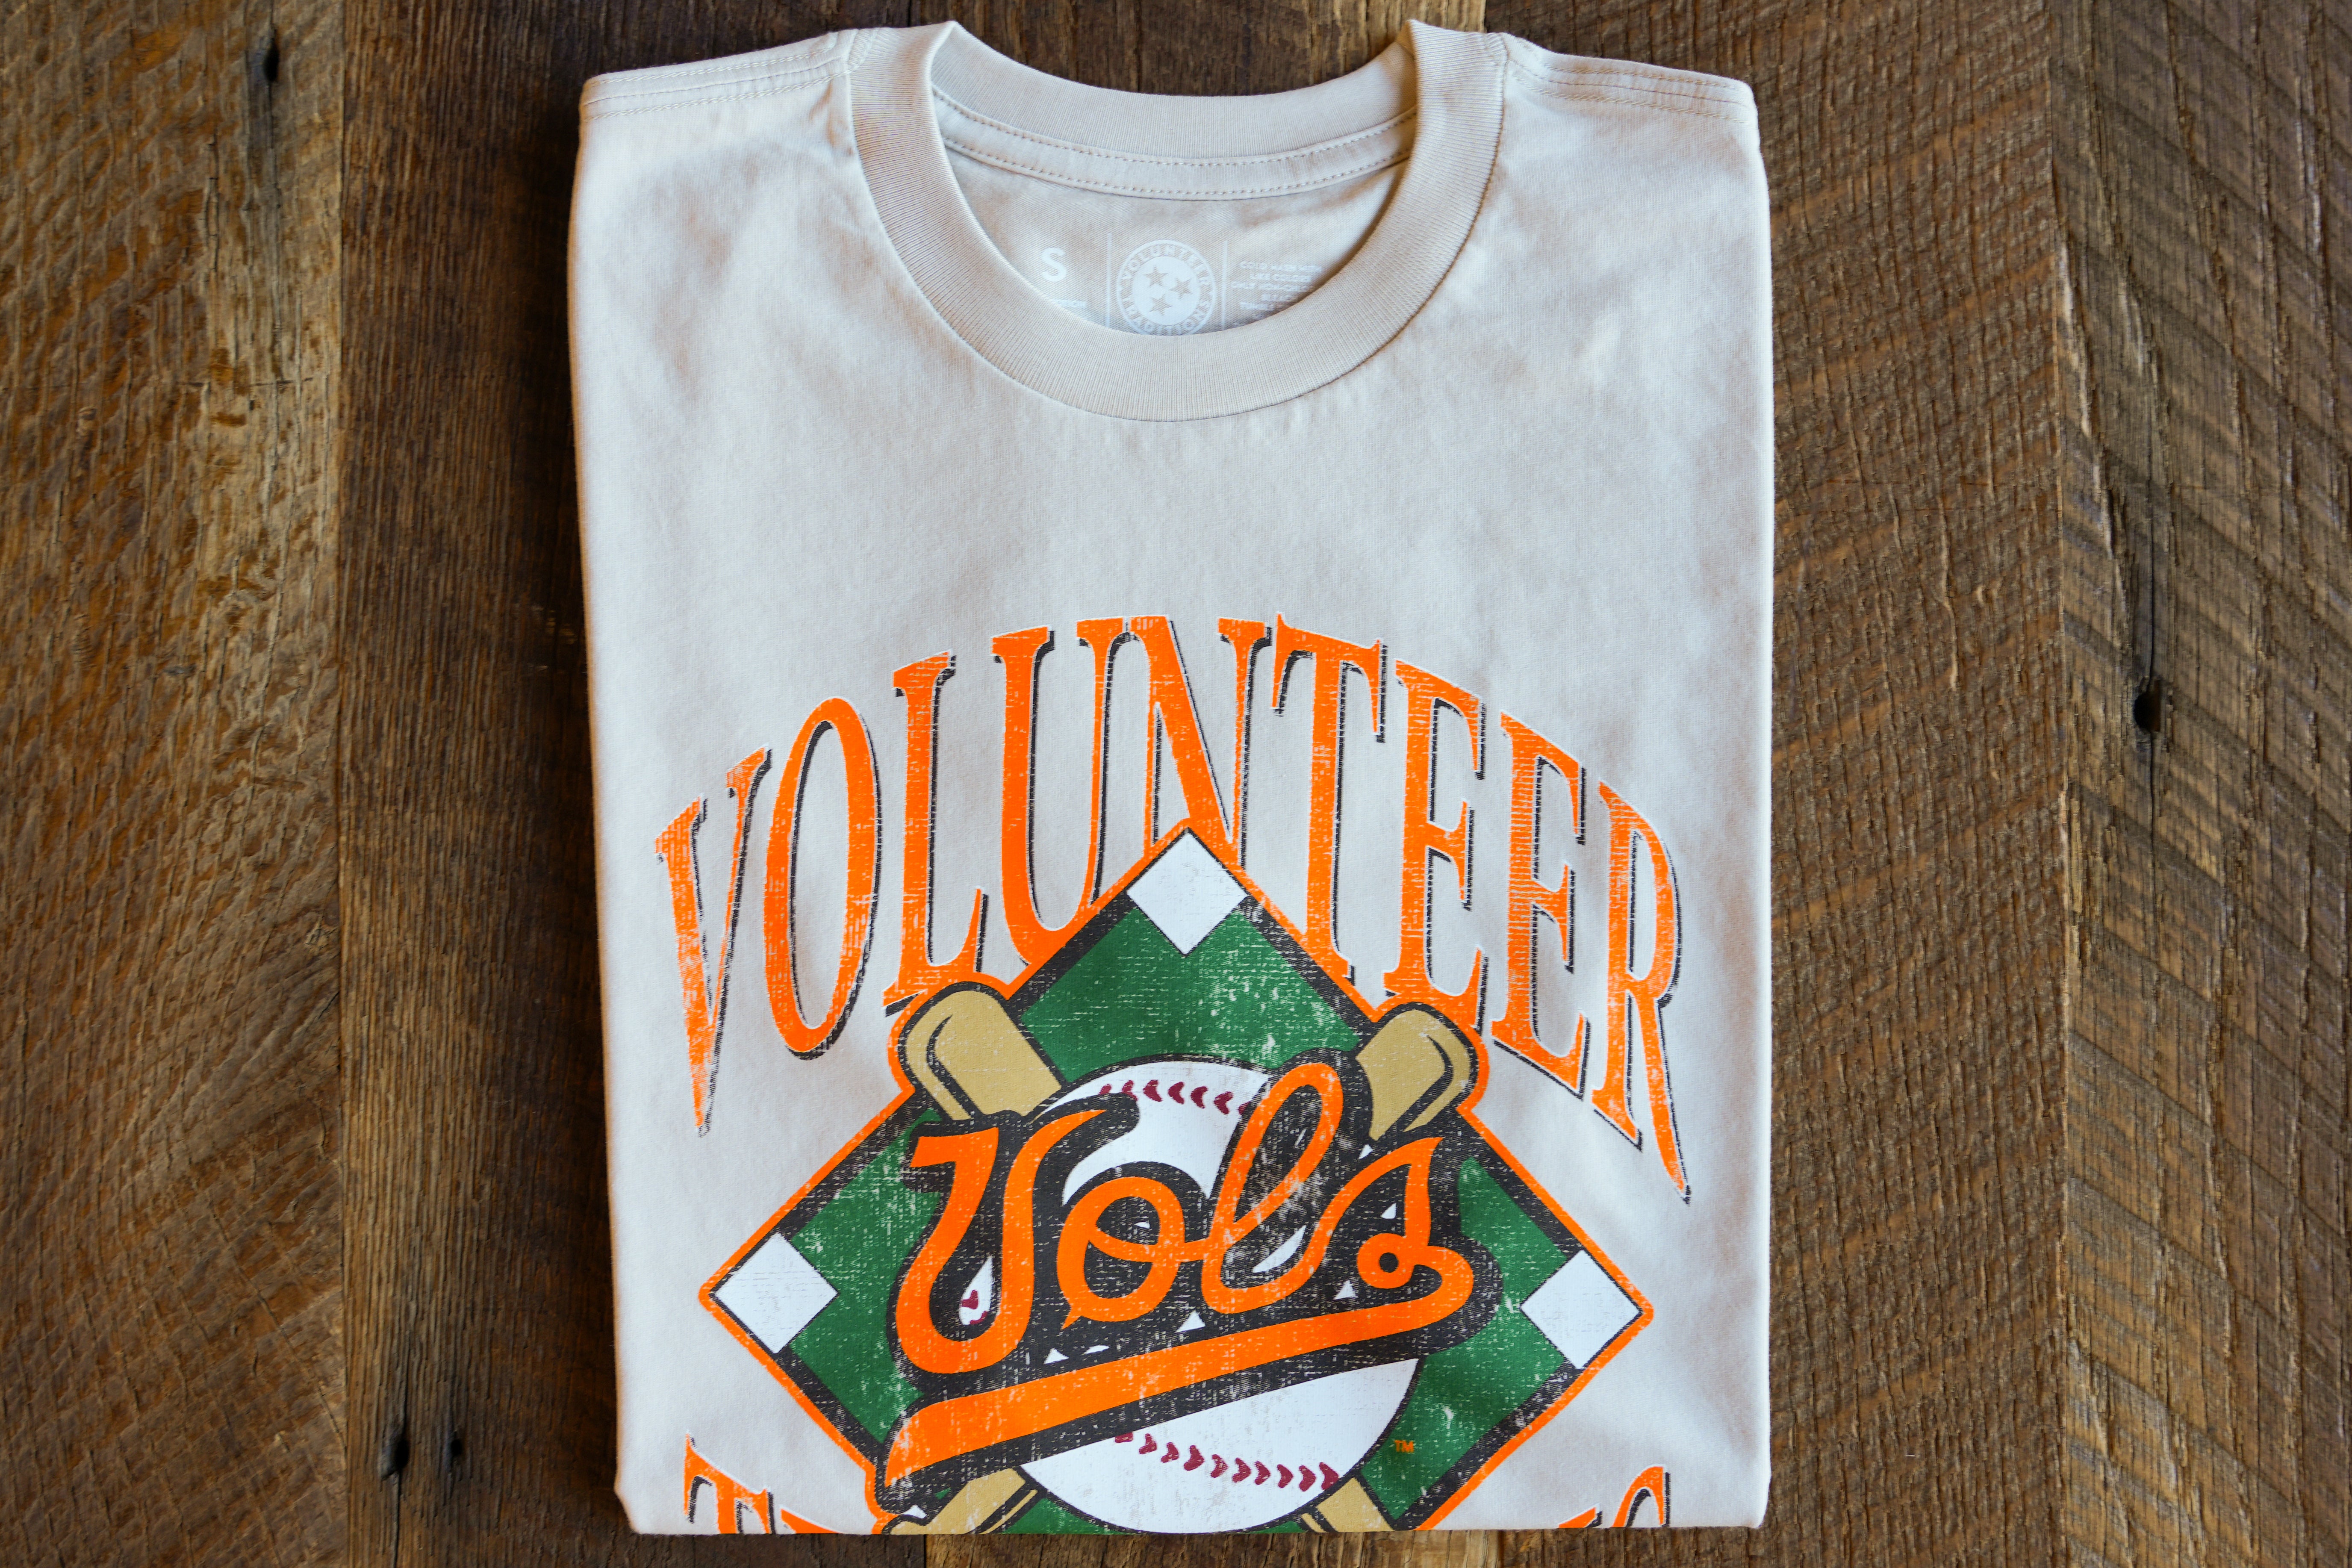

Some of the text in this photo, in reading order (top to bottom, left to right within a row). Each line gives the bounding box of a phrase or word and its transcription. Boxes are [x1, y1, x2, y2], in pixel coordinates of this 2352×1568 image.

[1041, 247, 1067, 282] S
[1121, 244, 1209, 285] VOLUNTEER
[654, 612, 1690, 1203] VOLUNTEER
[884, 1063, 1474, 1487] Vols
[1394, 1439, 1415, 1453] TM
